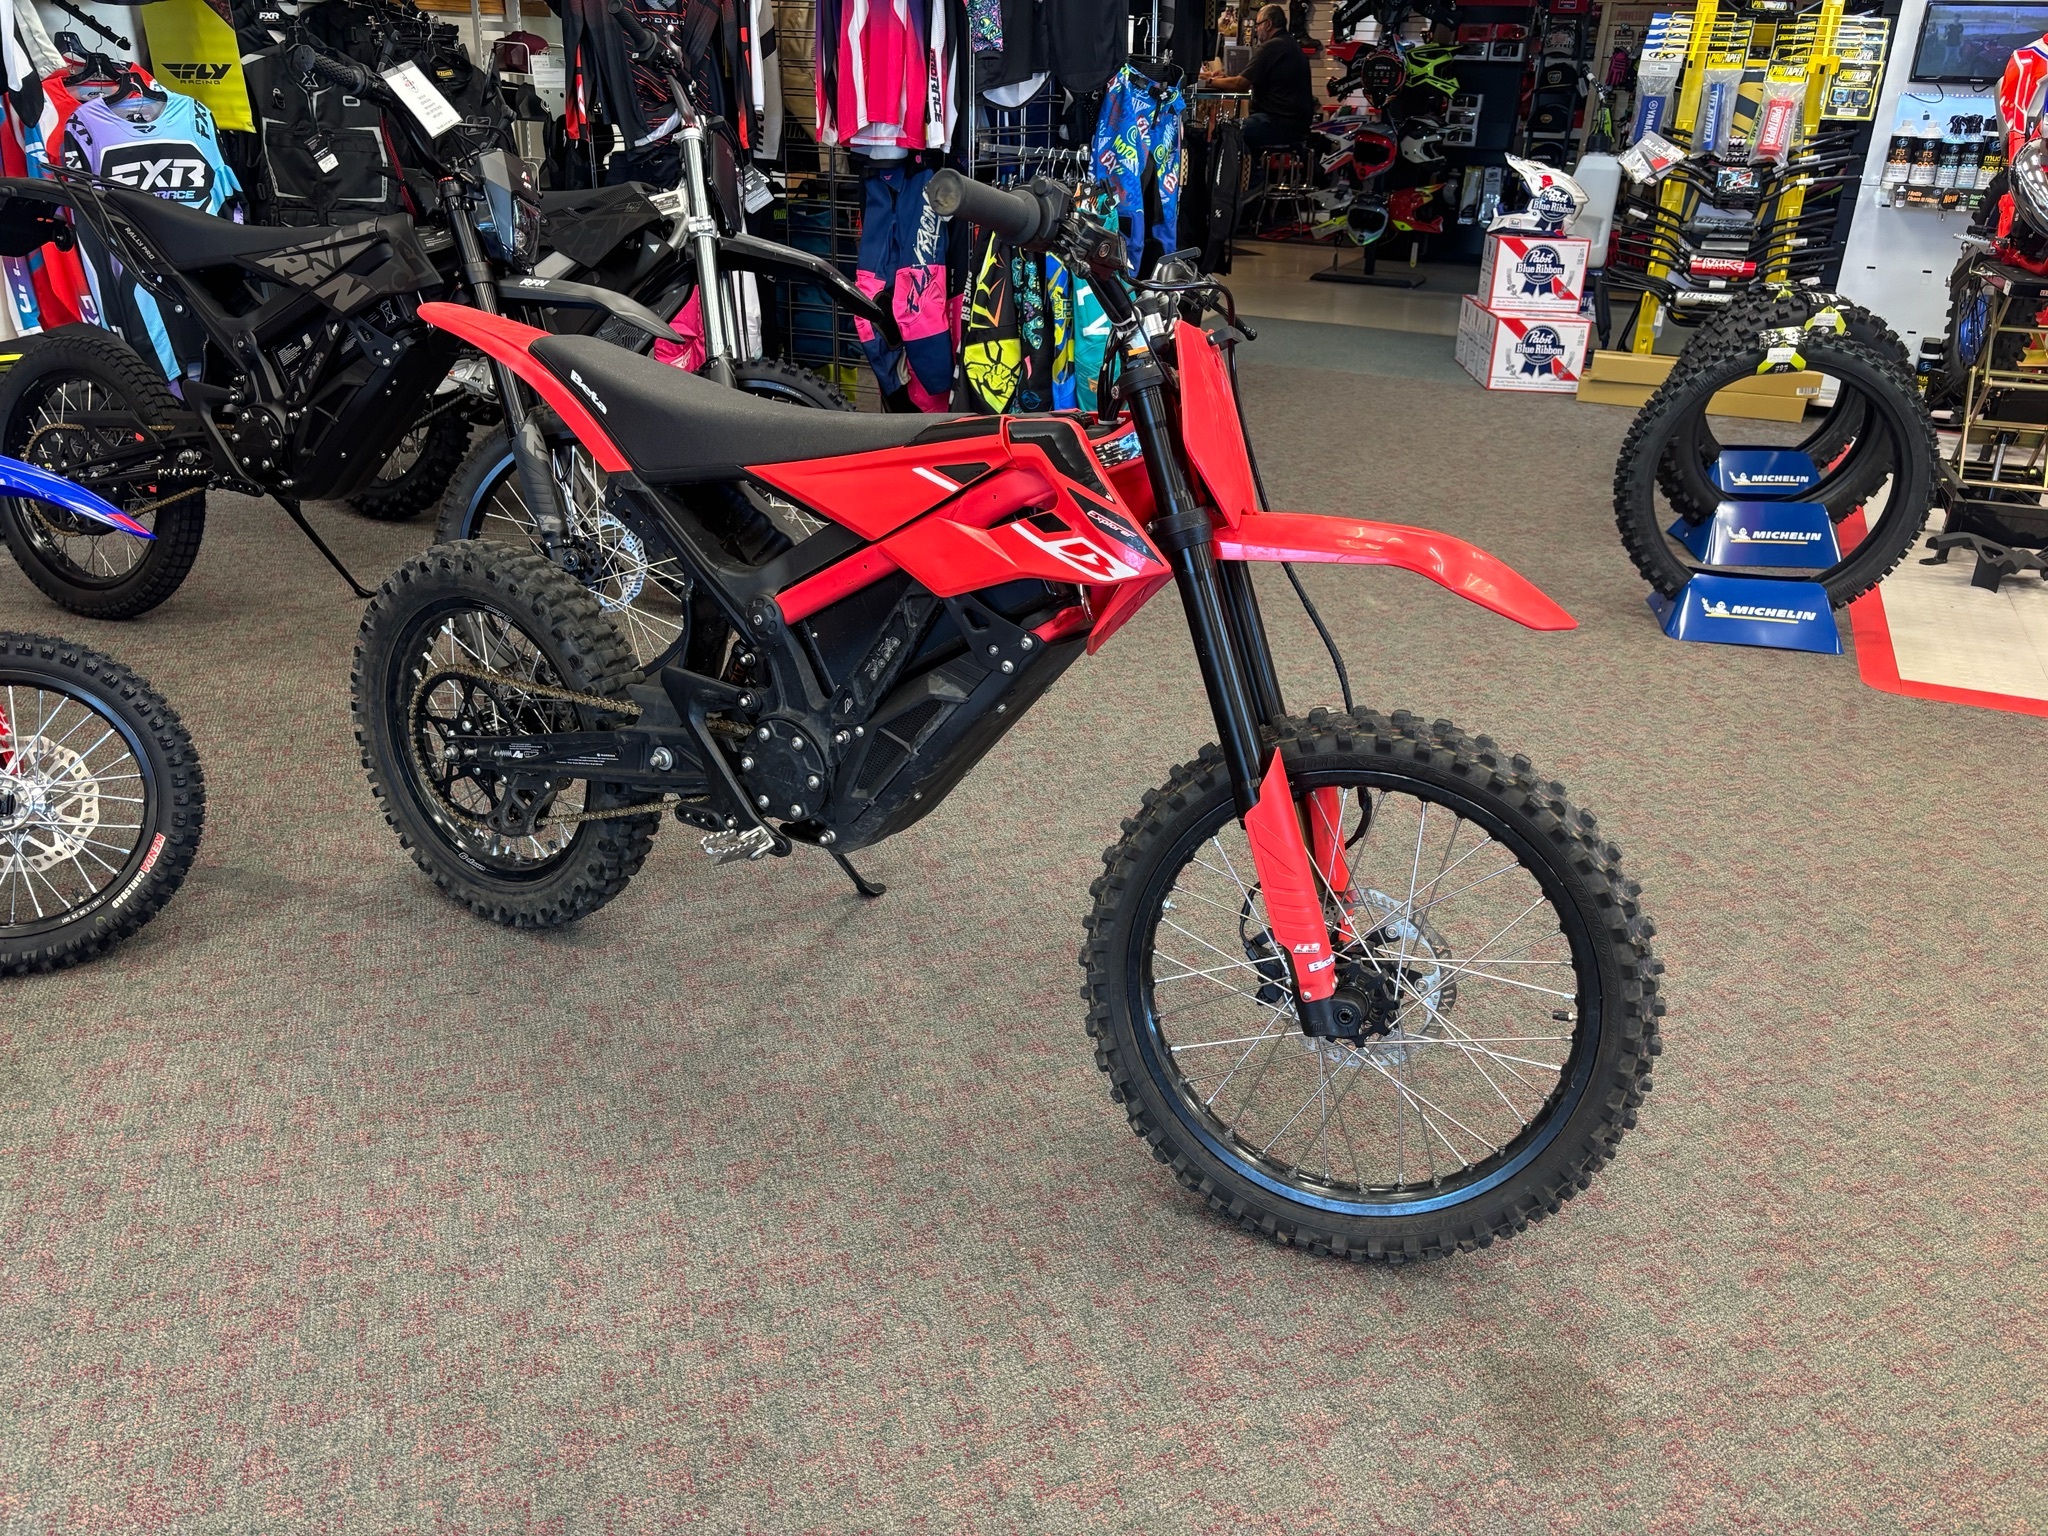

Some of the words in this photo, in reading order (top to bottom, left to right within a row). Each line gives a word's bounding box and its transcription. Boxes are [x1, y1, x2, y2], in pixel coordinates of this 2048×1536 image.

[258, 12, 279, 20] FXR
[161, 63, 232, 79] FLY
[1840, 70, 1871, 81] PROTAPER
[108, 158, 206, 190] FXR
[1545, 188, 1568, 203] Pabst
[1943, 194, 1959, 204] New
[1533, 200, 1550, 211] Blue
[1550, 203, 1574, 214] Ribbon
[125, 227, 144, 247] RALLY
[142, 245, 156, 261] PRO
[1529, 250, 1553, 263] Pabst
[1517, 262, 1535, 273] Blue
[1536, 263, 1563, 274] Ribbon
[518, 278, 549, 287] RFN
[961, 304, 971, 322] 68
[1529, 330, 1553, 343] Pabst
[1516, 343, 1535, 354] Blue
[1535, 344, 1563, 355] Ribbon
[570, 369, 607, 414] Beta
[1751, 474, 1809, 483] MICHELIN
[1087, 509, 1138, 538] Explorer
[1752, 530, 1822, 541] MICHELIN
[1731, 605, 1816, 620] MICHELIN
[140, 832, 166, 873] KENDA
[111, 870, 146, 909] CARLSBAD
